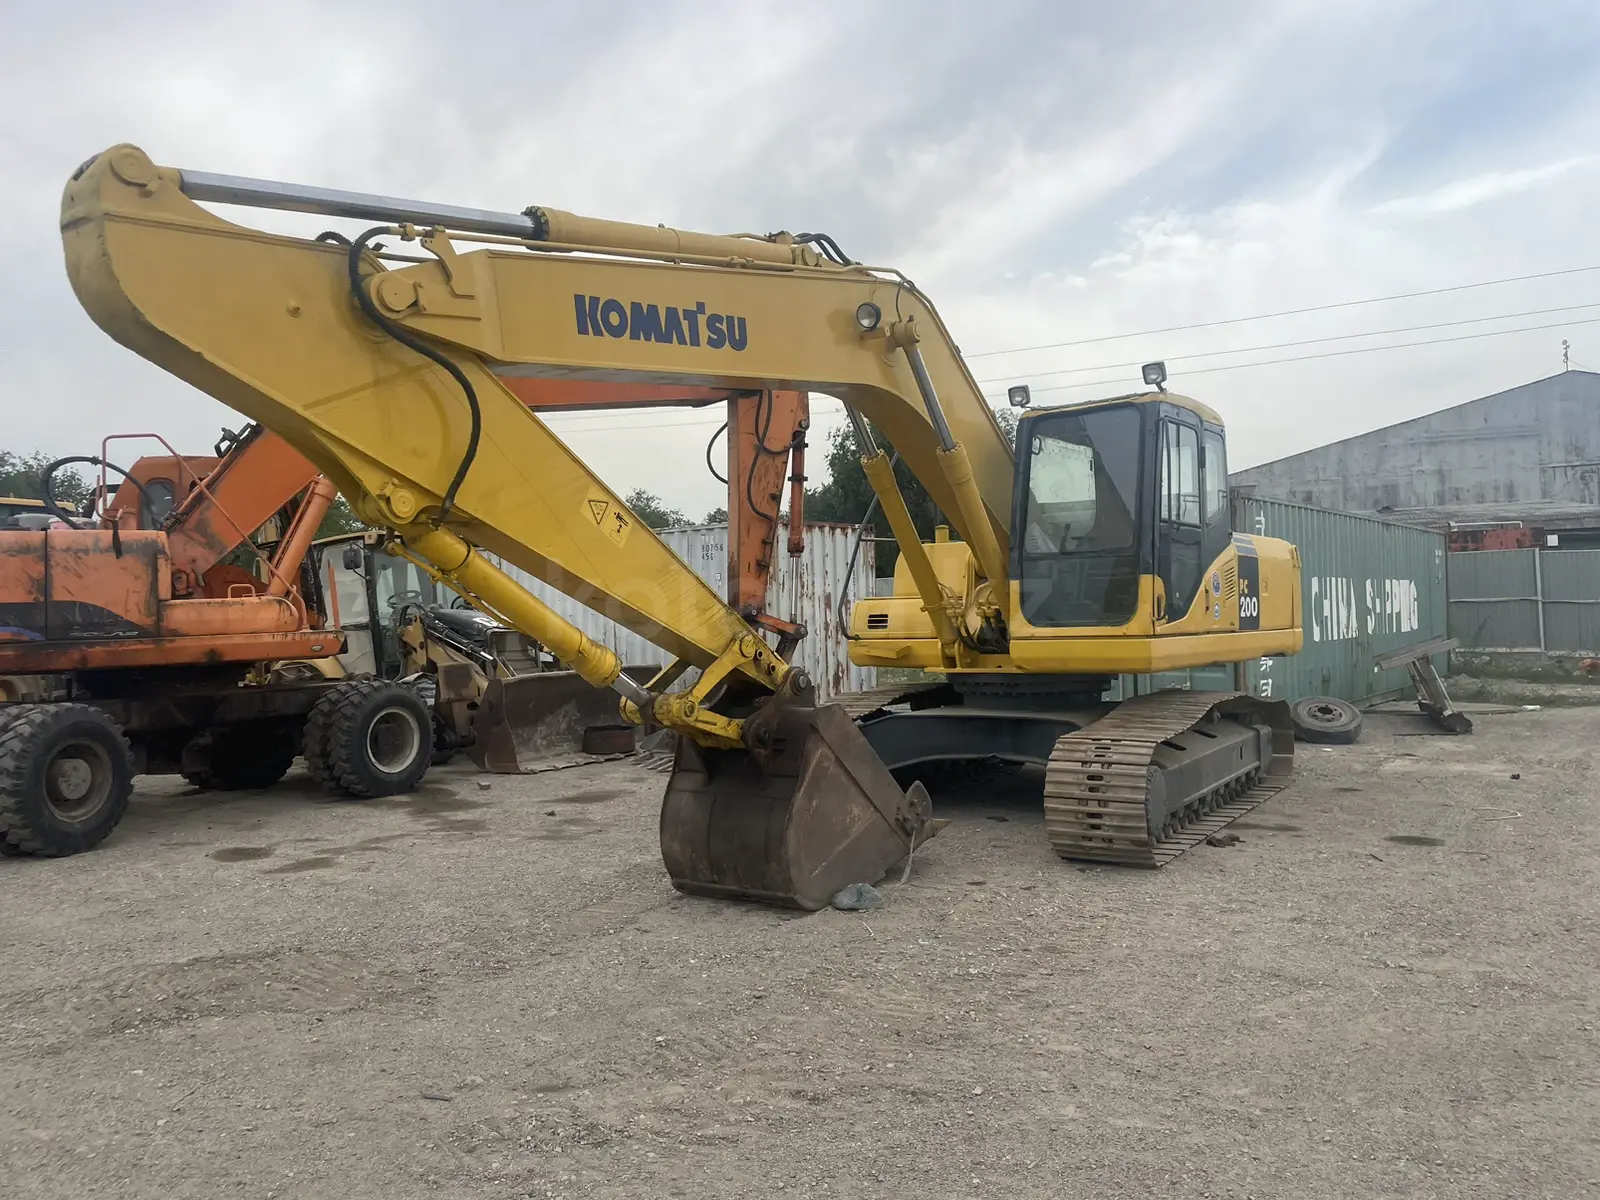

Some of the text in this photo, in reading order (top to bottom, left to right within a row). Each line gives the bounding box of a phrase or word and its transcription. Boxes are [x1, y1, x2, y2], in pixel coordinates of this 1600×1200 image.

[574, 293, 748, 352] KOMATSU
[1239, 578, 1249, 594] PC
[1240, 596, 1258, 617] 200
[1311, 576, 1359, 642] CHINA
